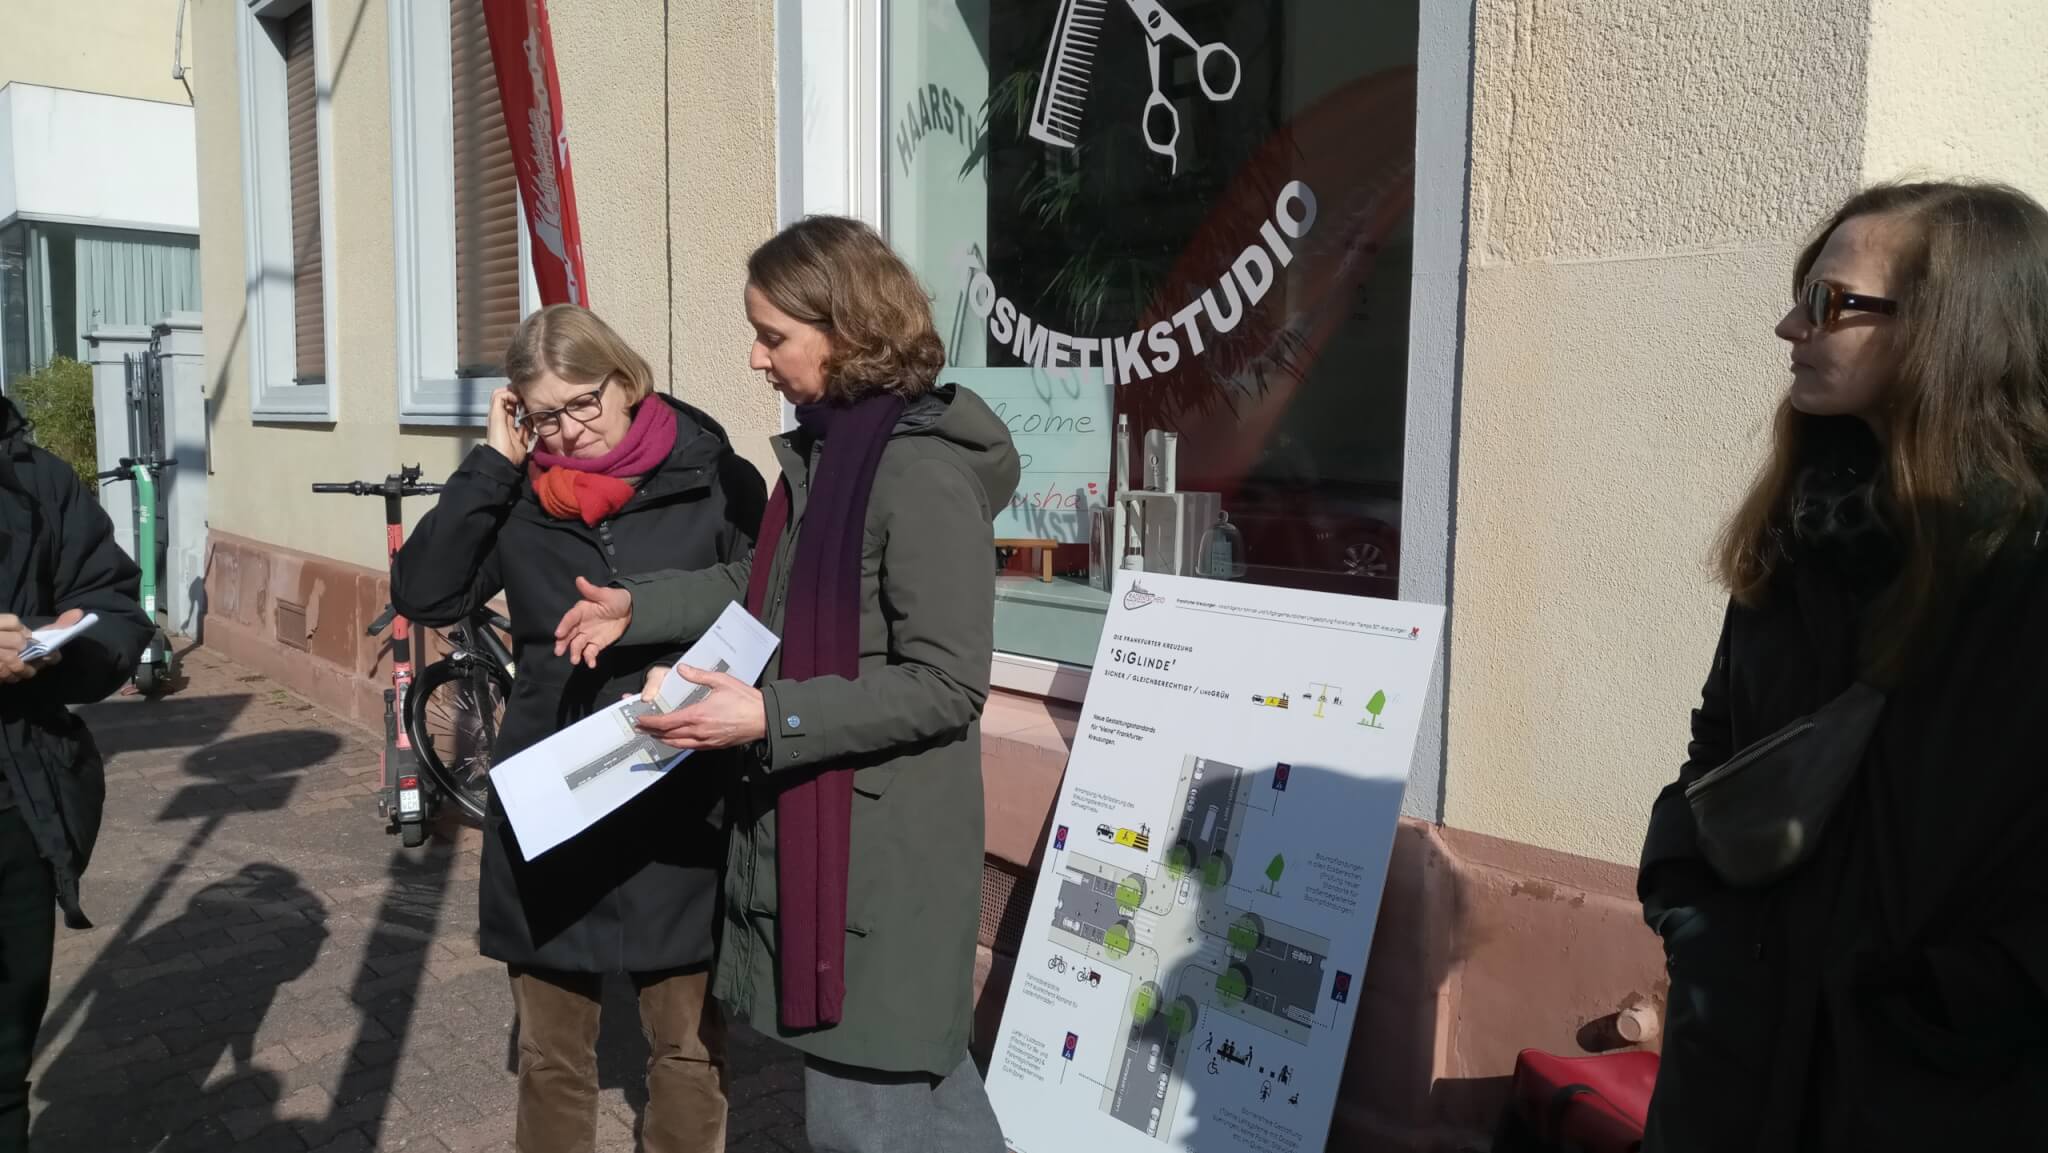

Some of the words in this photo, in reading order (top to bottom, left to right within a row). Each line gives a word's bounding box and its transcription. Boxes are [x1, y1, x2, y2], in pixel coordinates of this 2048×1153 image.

[1124, 636, 1161, 647] FRANKFURTER
[1162, 642, 1193, 653] KREUZUNG
[1104, 669, 1125, 679] SICHER
[1132, 675, 1192, 692] GLEICHBERECHTIGT
